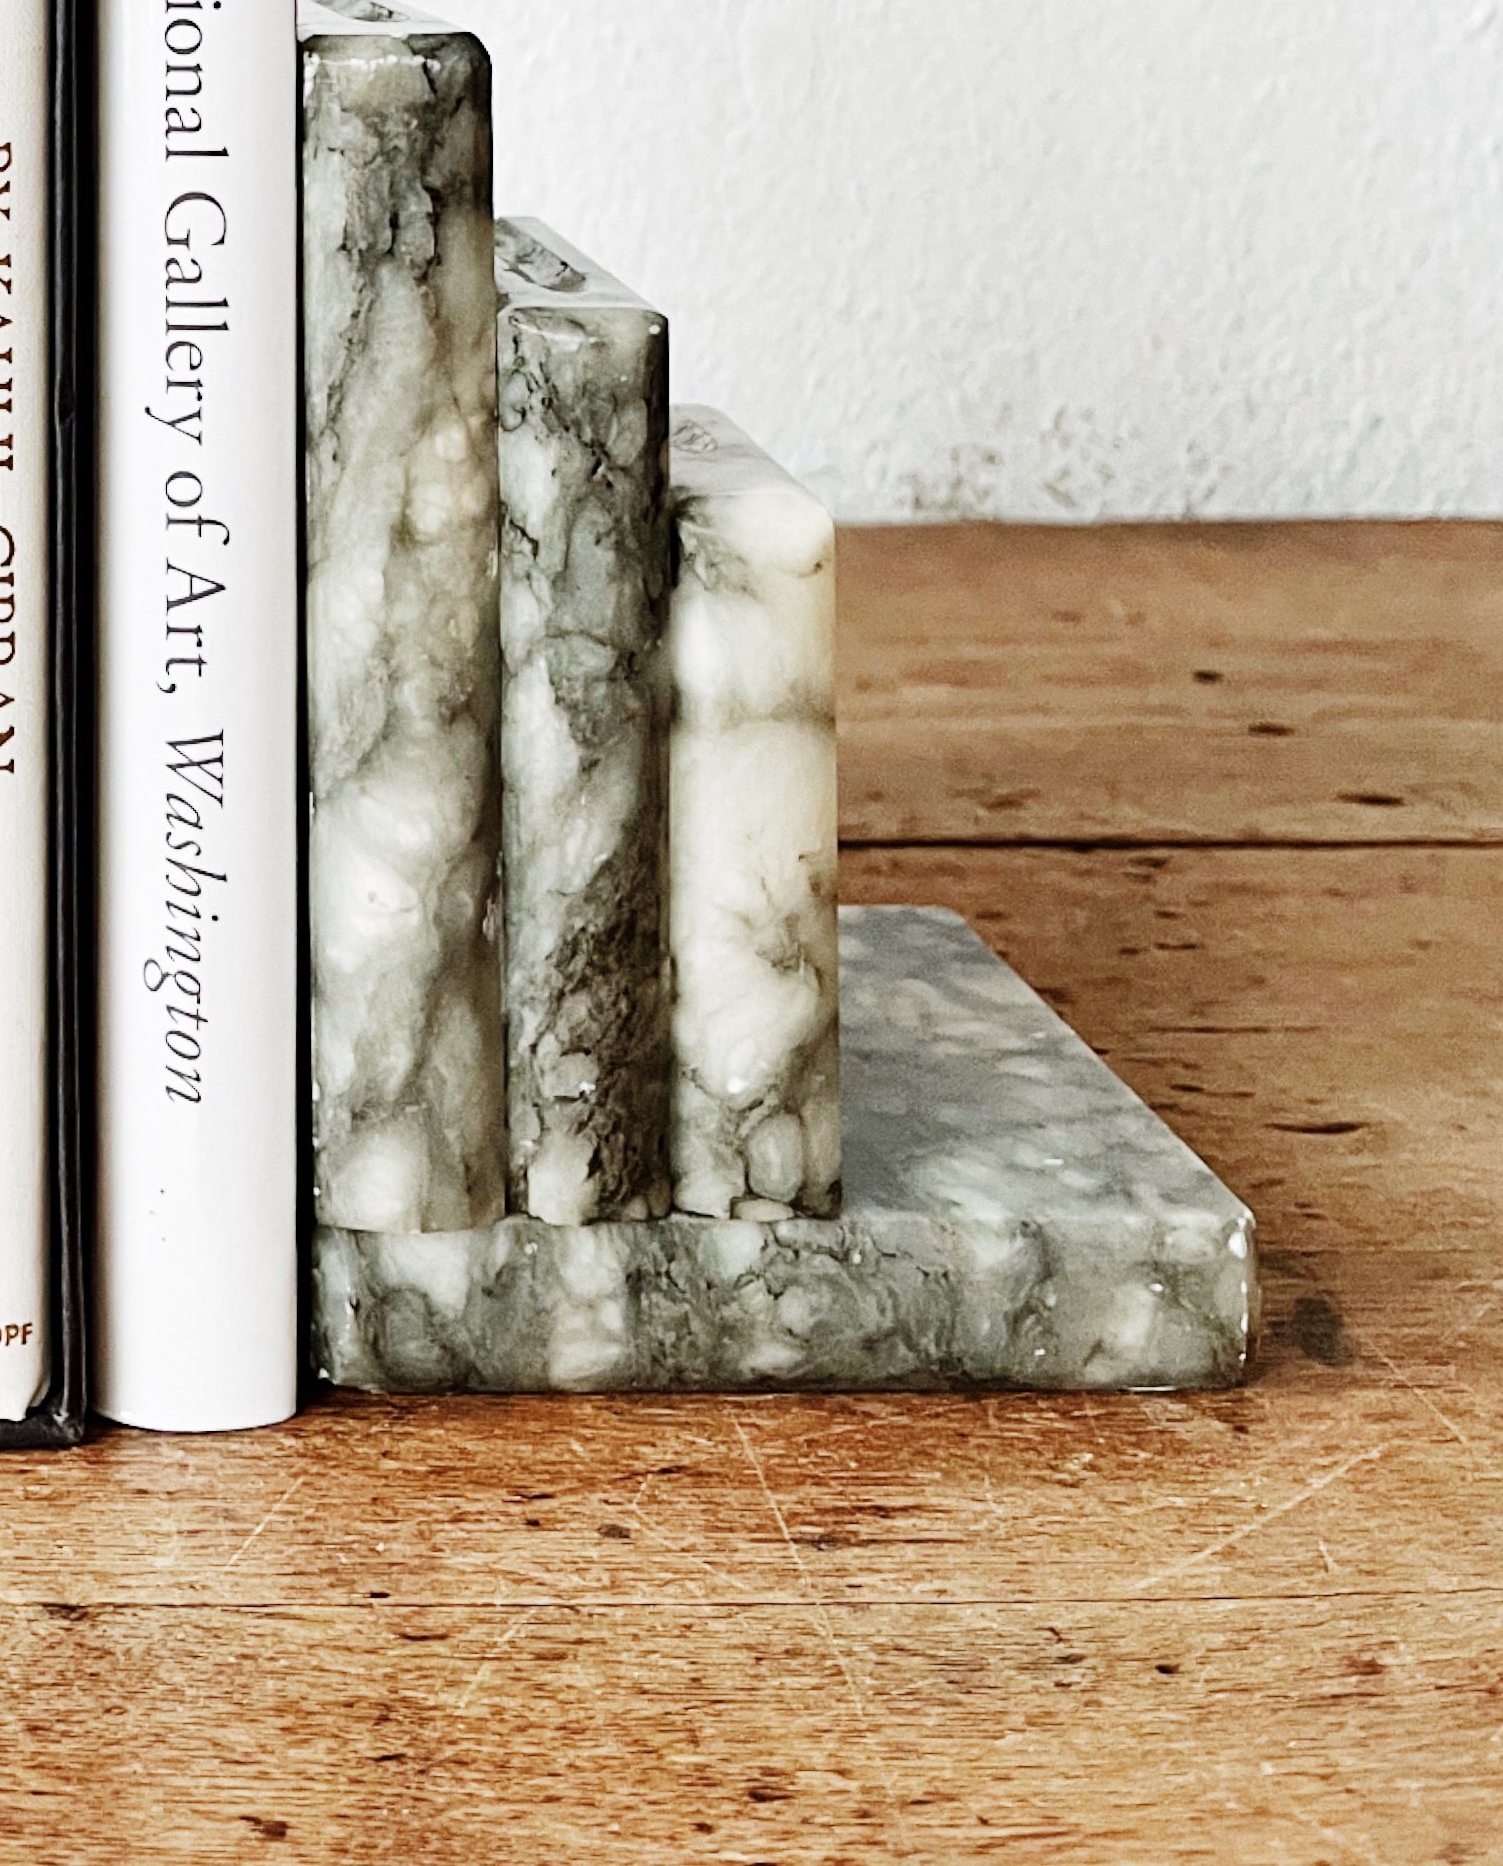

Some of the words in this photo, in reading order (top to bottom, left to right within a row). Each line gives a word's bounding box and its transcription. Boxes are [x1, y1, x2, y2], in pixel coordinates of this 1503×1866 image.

[144, 191, 229, 445] Gallery
[165, 471, 230, 546] of
[158, 559, 226, 694] Art,
[144, 729, 228, 1103] Washington
